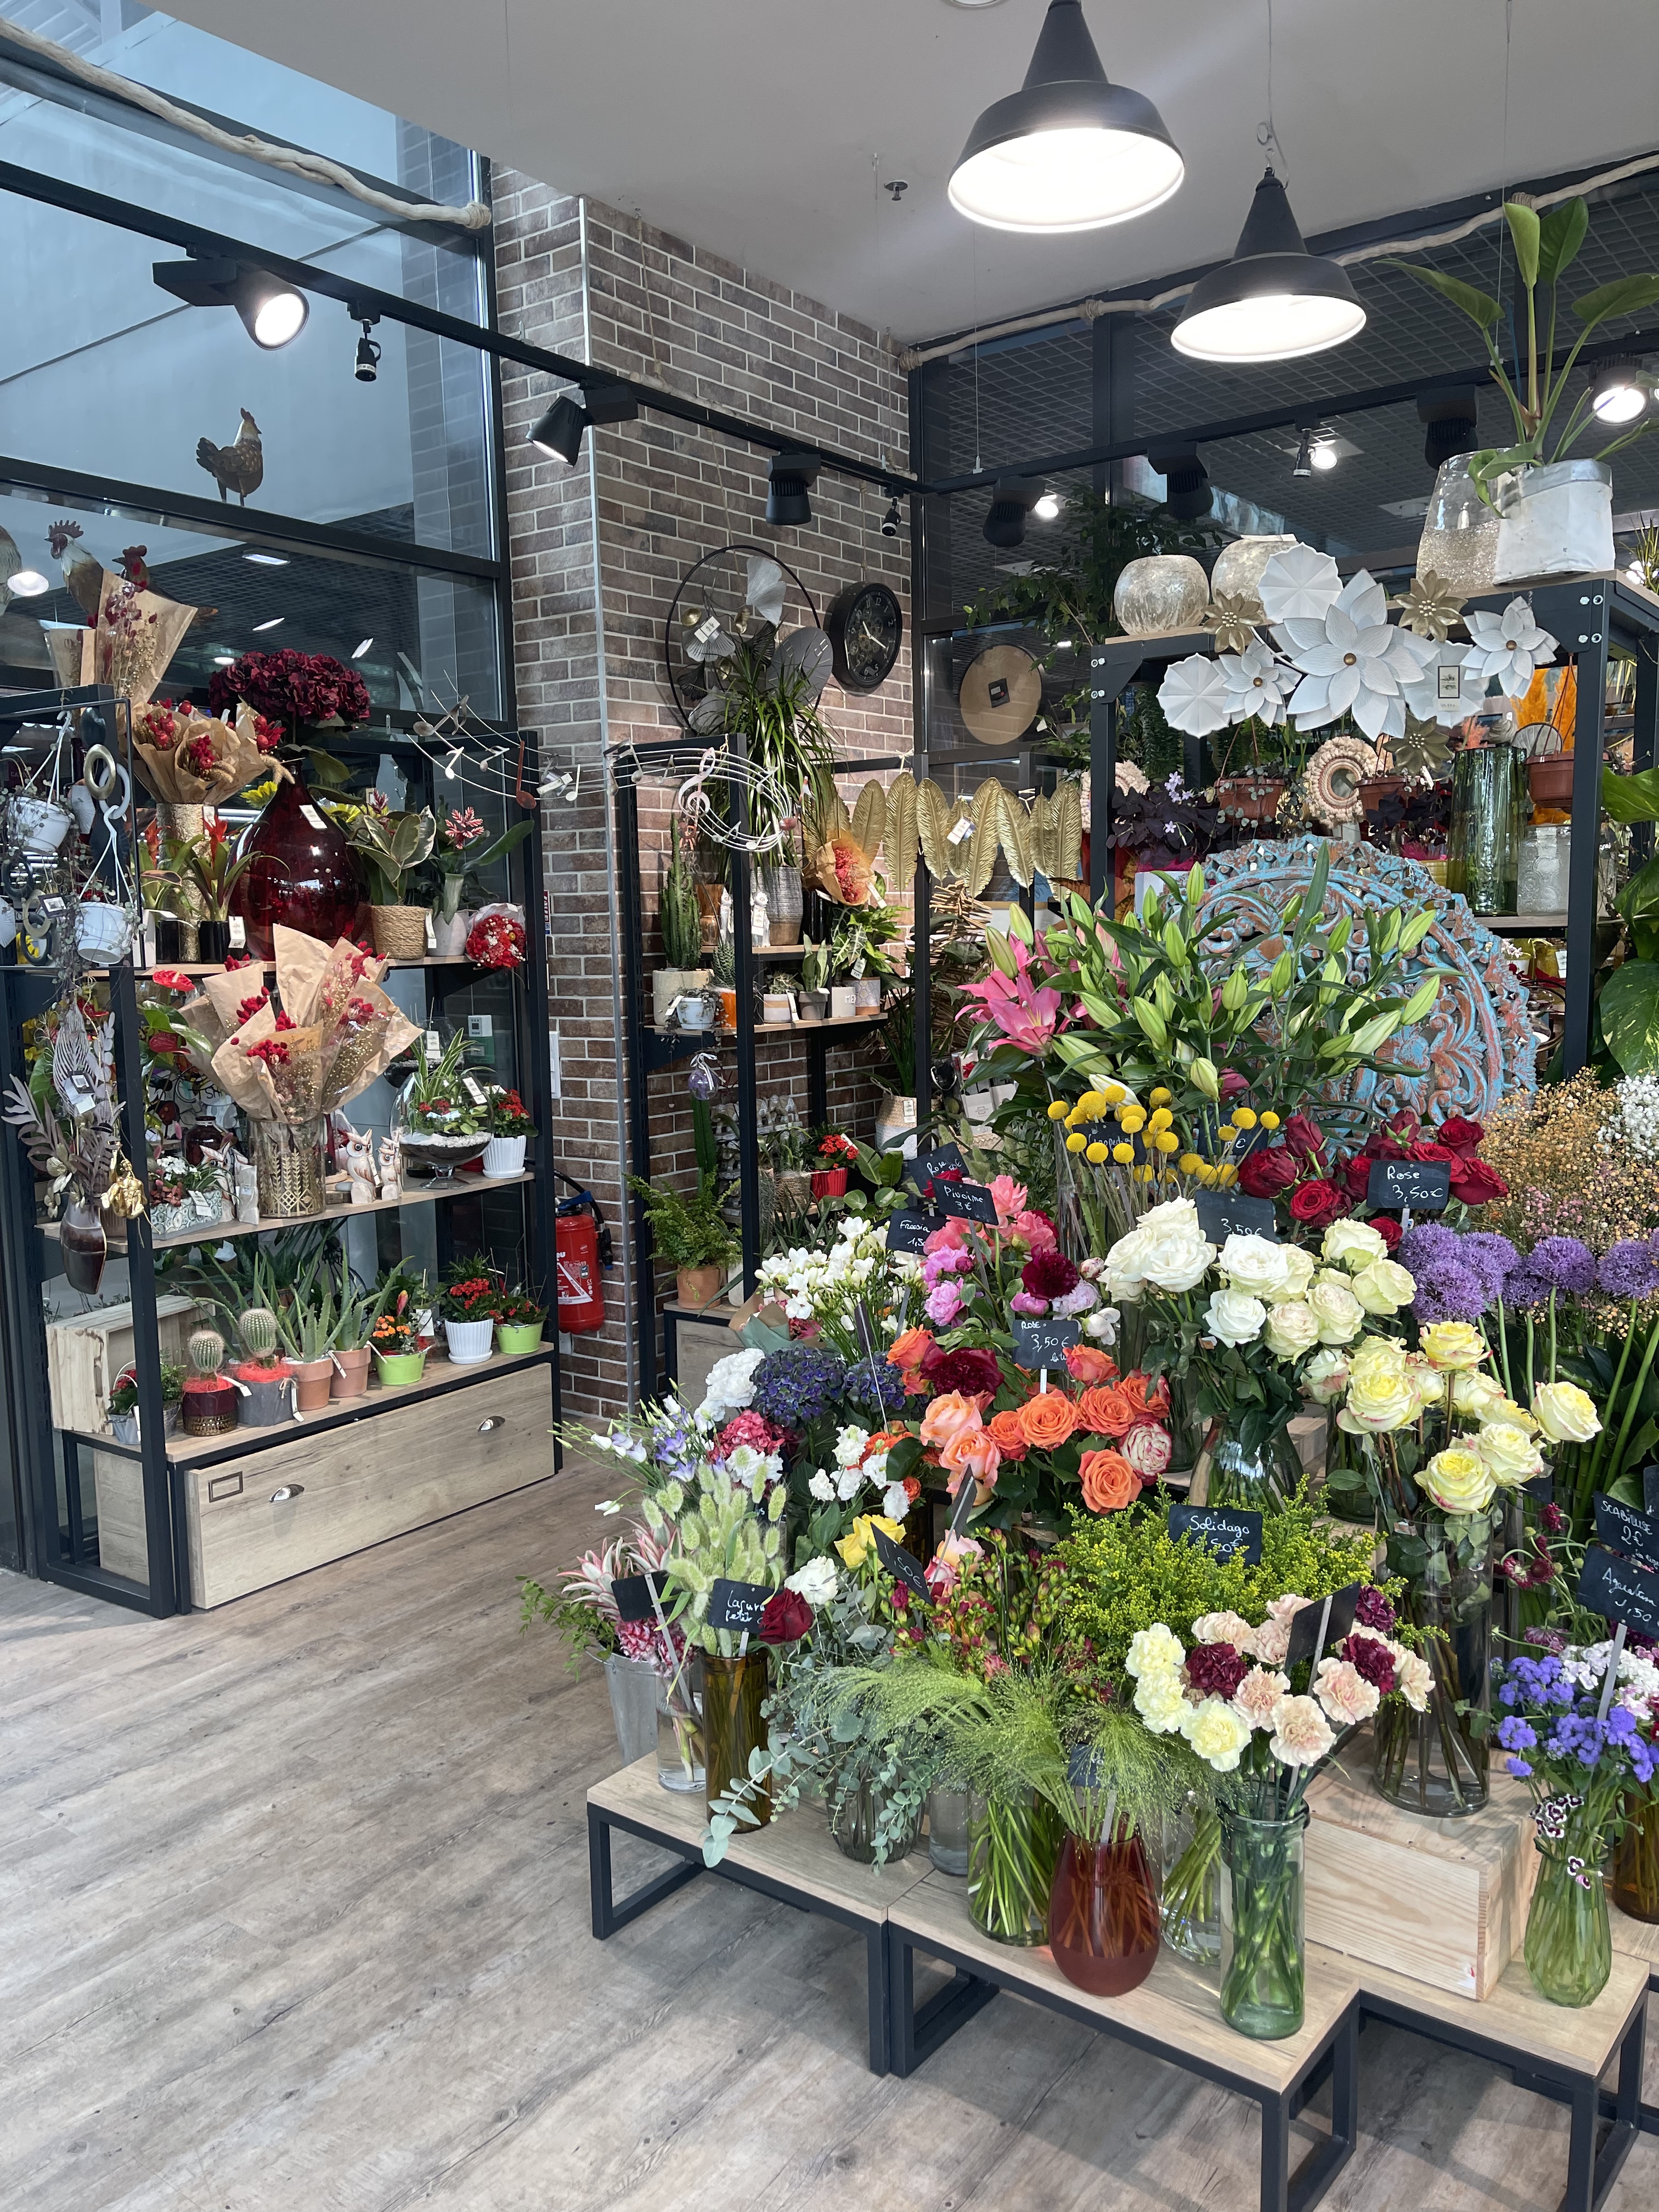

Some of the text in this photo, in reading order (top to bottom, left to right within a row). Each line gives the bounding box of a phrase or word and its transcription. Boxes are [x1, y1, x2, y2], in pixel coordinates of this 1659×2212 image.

[875, 597, 881, 606] 12
[1387, 1165, 1420, 1180] Rose
[1392, 1184, 1444, 1203] 3,50€
[900, 1219, 930, 1233] Freesia
[1190, 1515, 1250, 1538] Solidago
